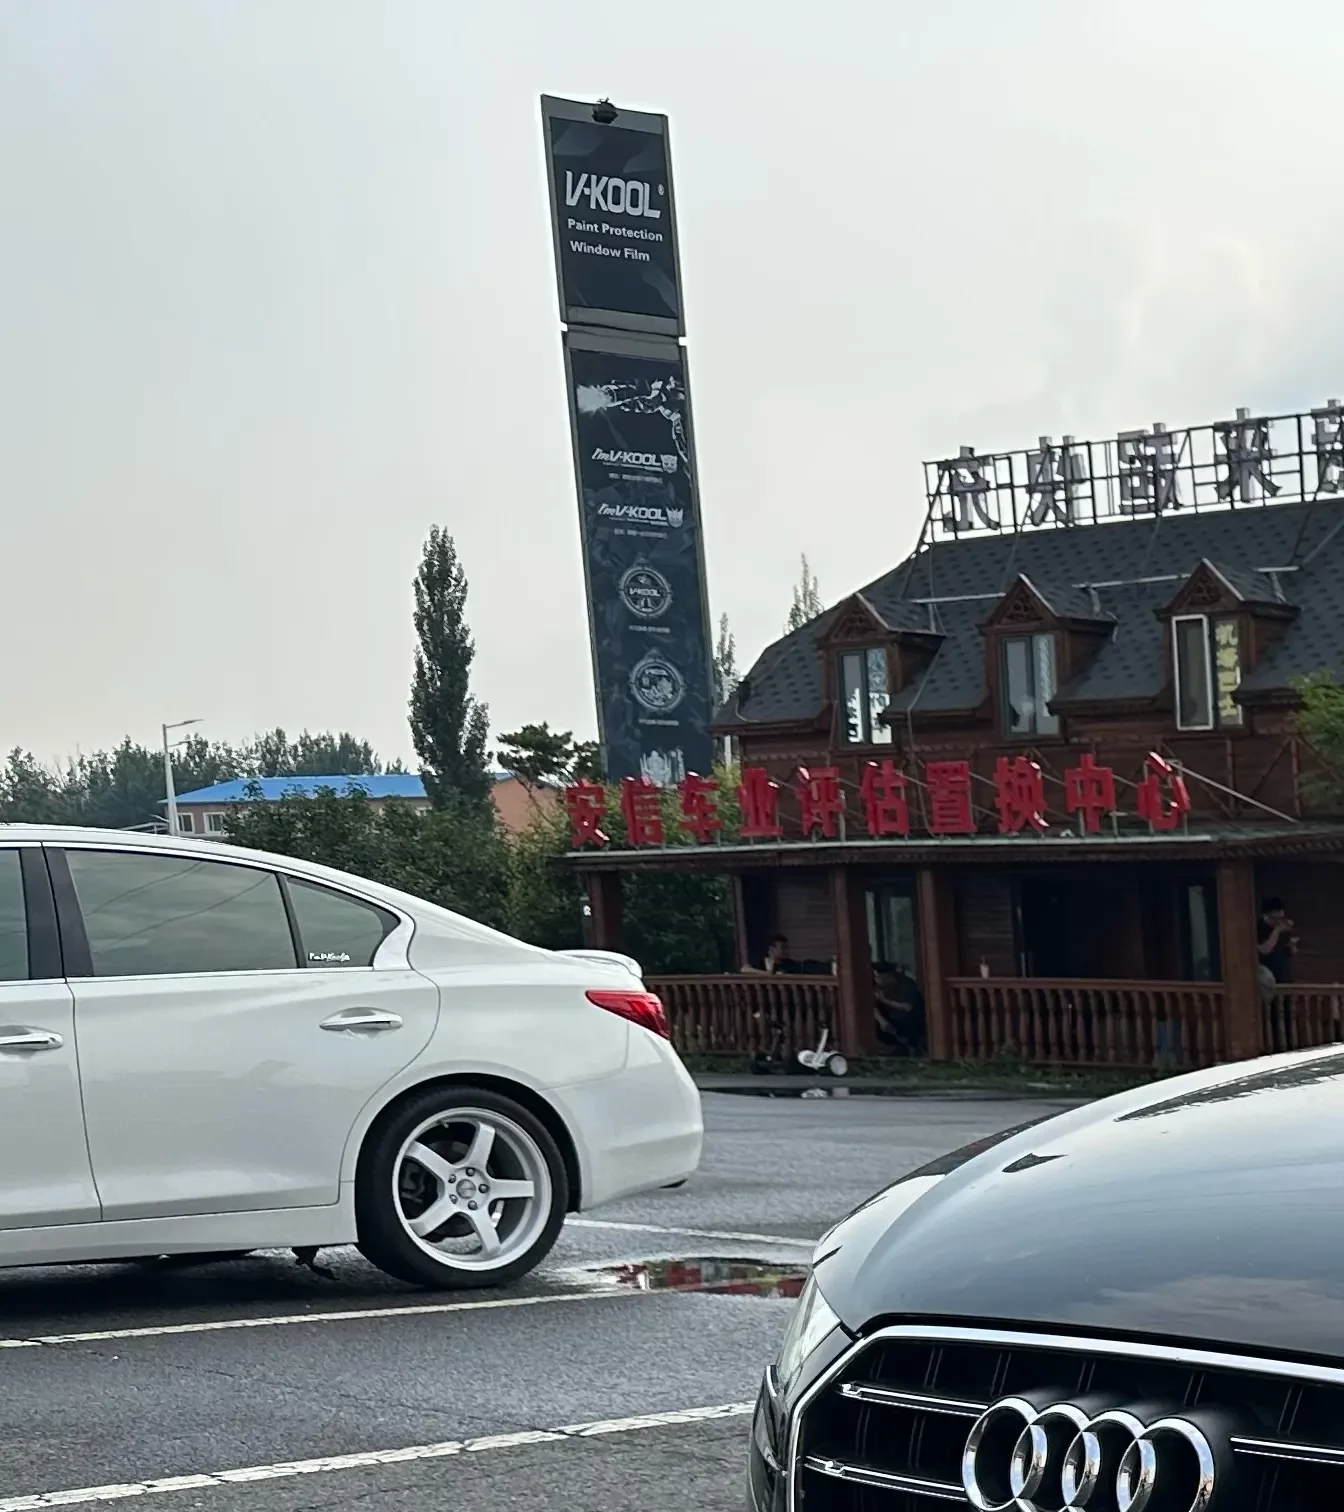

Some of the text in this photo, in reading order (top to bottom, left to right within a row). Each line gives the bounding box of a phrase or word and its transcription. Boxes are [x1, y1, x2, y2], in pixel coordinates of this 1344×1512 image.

[568, 218, 664, 242] Paint Protection
[570, 240, 650, 262] Window Film
[609, 449, 661, 466] V-KOOL
[565, 751, 1192, 847] 安信车业评估置换中心
